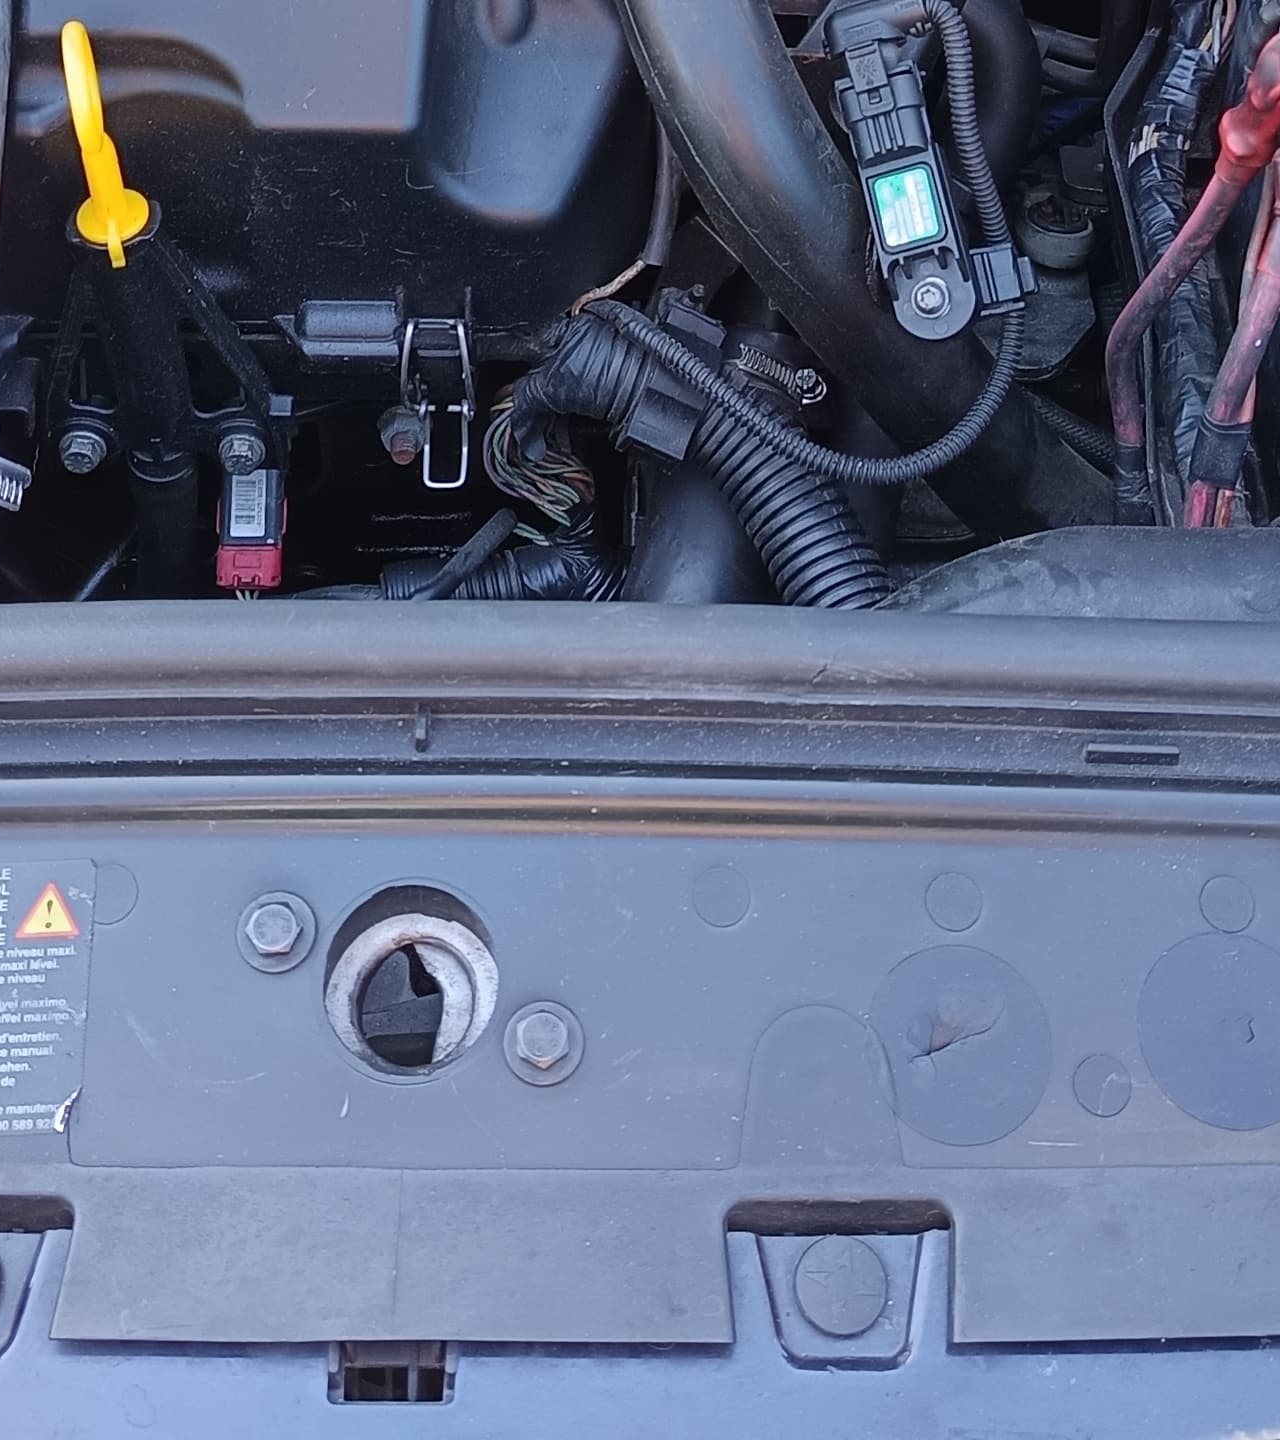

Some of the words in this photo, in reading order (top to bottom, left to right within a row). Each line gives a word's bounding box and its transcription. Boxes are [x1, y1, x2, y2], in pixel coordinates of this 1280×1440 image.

[6, 947, 45, 959] niveau
[7, 972, 46, 984] niveau
[0, 1075, 17, 1087] de
[11, 1118, 34, 1131] 589
